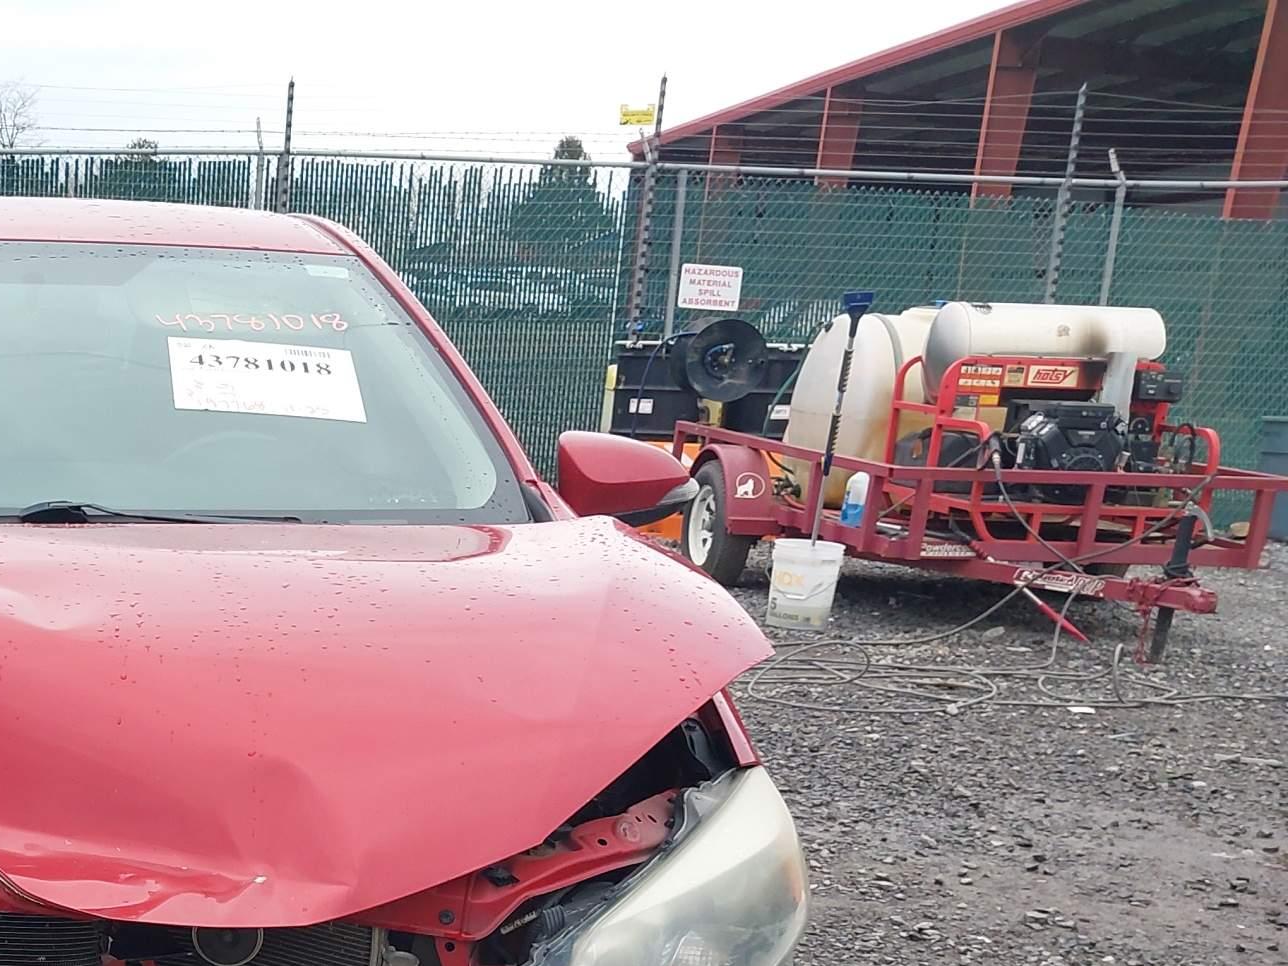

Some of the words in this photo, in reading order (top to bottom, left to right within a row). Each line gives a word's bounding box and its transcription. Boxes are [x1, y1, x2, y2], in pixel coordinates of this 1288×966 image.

[684, 267, 740, 278] HAZARDOUS
[689, 278, 732, 288] MATERIAL
[698, 288, 721, 297] SPILL
[681, 297, 736, 308] ABSORBENT
[189, 353, 332, 376] 43781018
